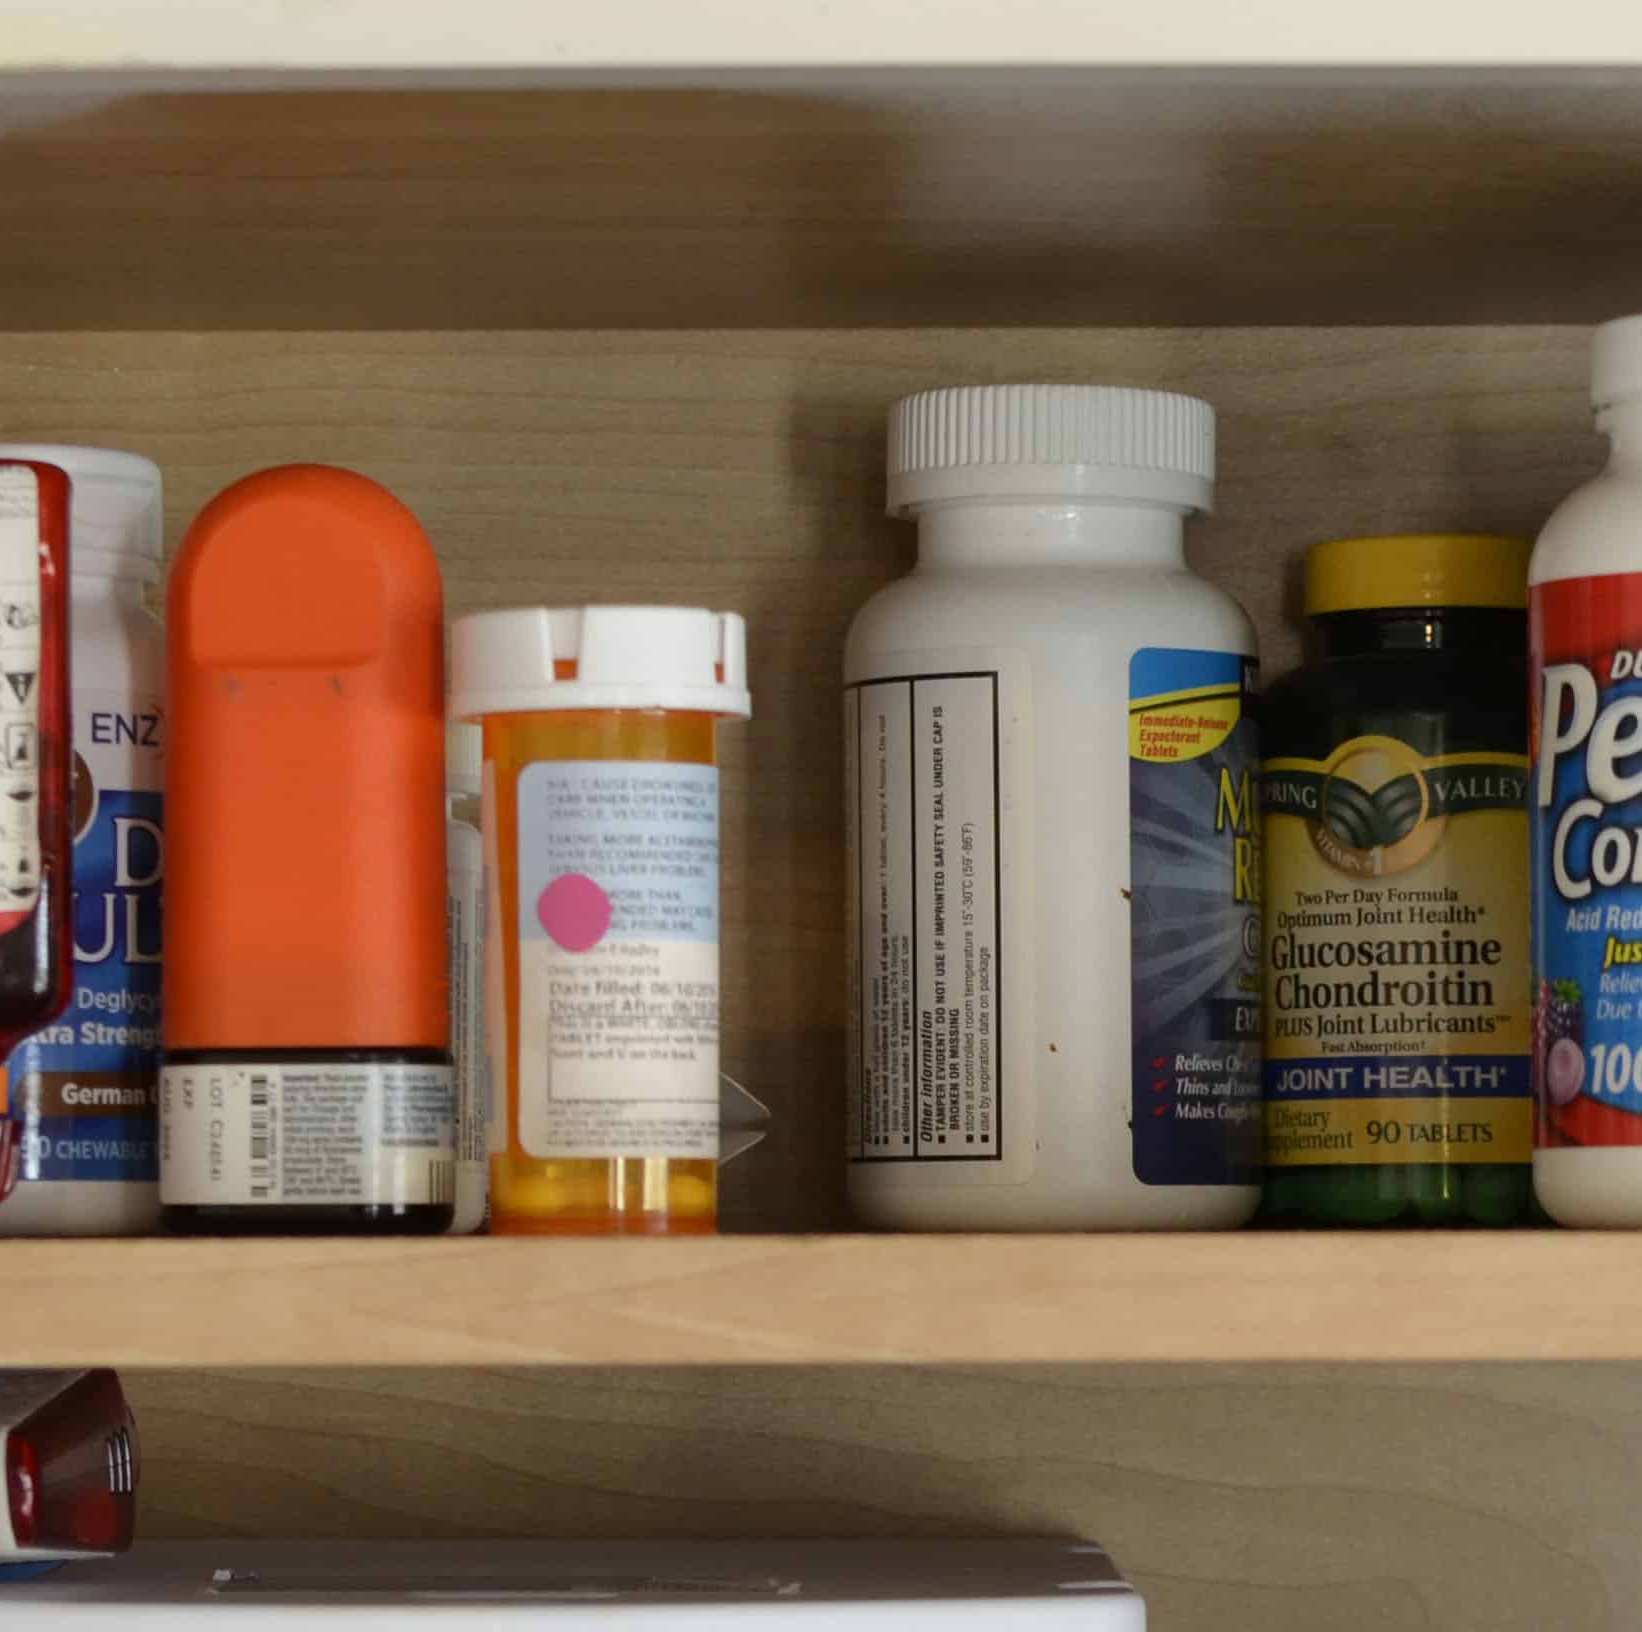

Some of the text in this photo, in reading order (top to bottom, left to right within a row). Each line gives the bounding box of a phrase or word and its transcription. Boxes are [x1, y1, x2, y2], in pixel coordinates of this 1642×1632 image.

[1140, 729, 1201, 745] Expectorant
[1140, 745, 1178, 758] Tablets
[1435, 776, 1529, 803] VALLEY
[1295, 886, 1459, 907] Two Per Day Formula
[934, 704, 947, 1131] TAMPER DO NOT USE IF IMPRINTED SAFETY SEAL UNDER CAP IS
[1277, 908, 1351, 931] Optimum
[1356, 904, 1402, 926] Joint
[1565, 907, 1601, 932] Acid
[1271, 929, 1502, 970] Glucosamine
[1275, 970, 1494, 1010] Chondroitin
[1596, 998, 1633, 1019] Due
[961, 931, 975, 1132] store at controlled room temperature
[1276, 1014, 1314, 1037] PLUS
[1317, 1009, 1366, 1038] Joint
[978, 945, 991, 1132] use by expiration date on package
[1321, 1041, 1346, 1055] Fast
[900, 1052, 910, 1083] under
[919, 1009, 934, 1142] Other information
[949, 1008, 961, 1131] BROKEN OR MISSING
[1175, 1053, 1223, 1073] Relieves
[1176, 1077, 1209, 1096] Thins
[1277, 1066, 1355, 1092] JOINT
[61, 1081, 146, 1106] German
[900, 1087, 910, 1132] children
[1176, 1101, 1215, 1120] Makes
[1273, 1110, 1332, 1131] Dietary
[1366, 1119, 1494, 1145] 90 TABLETS
